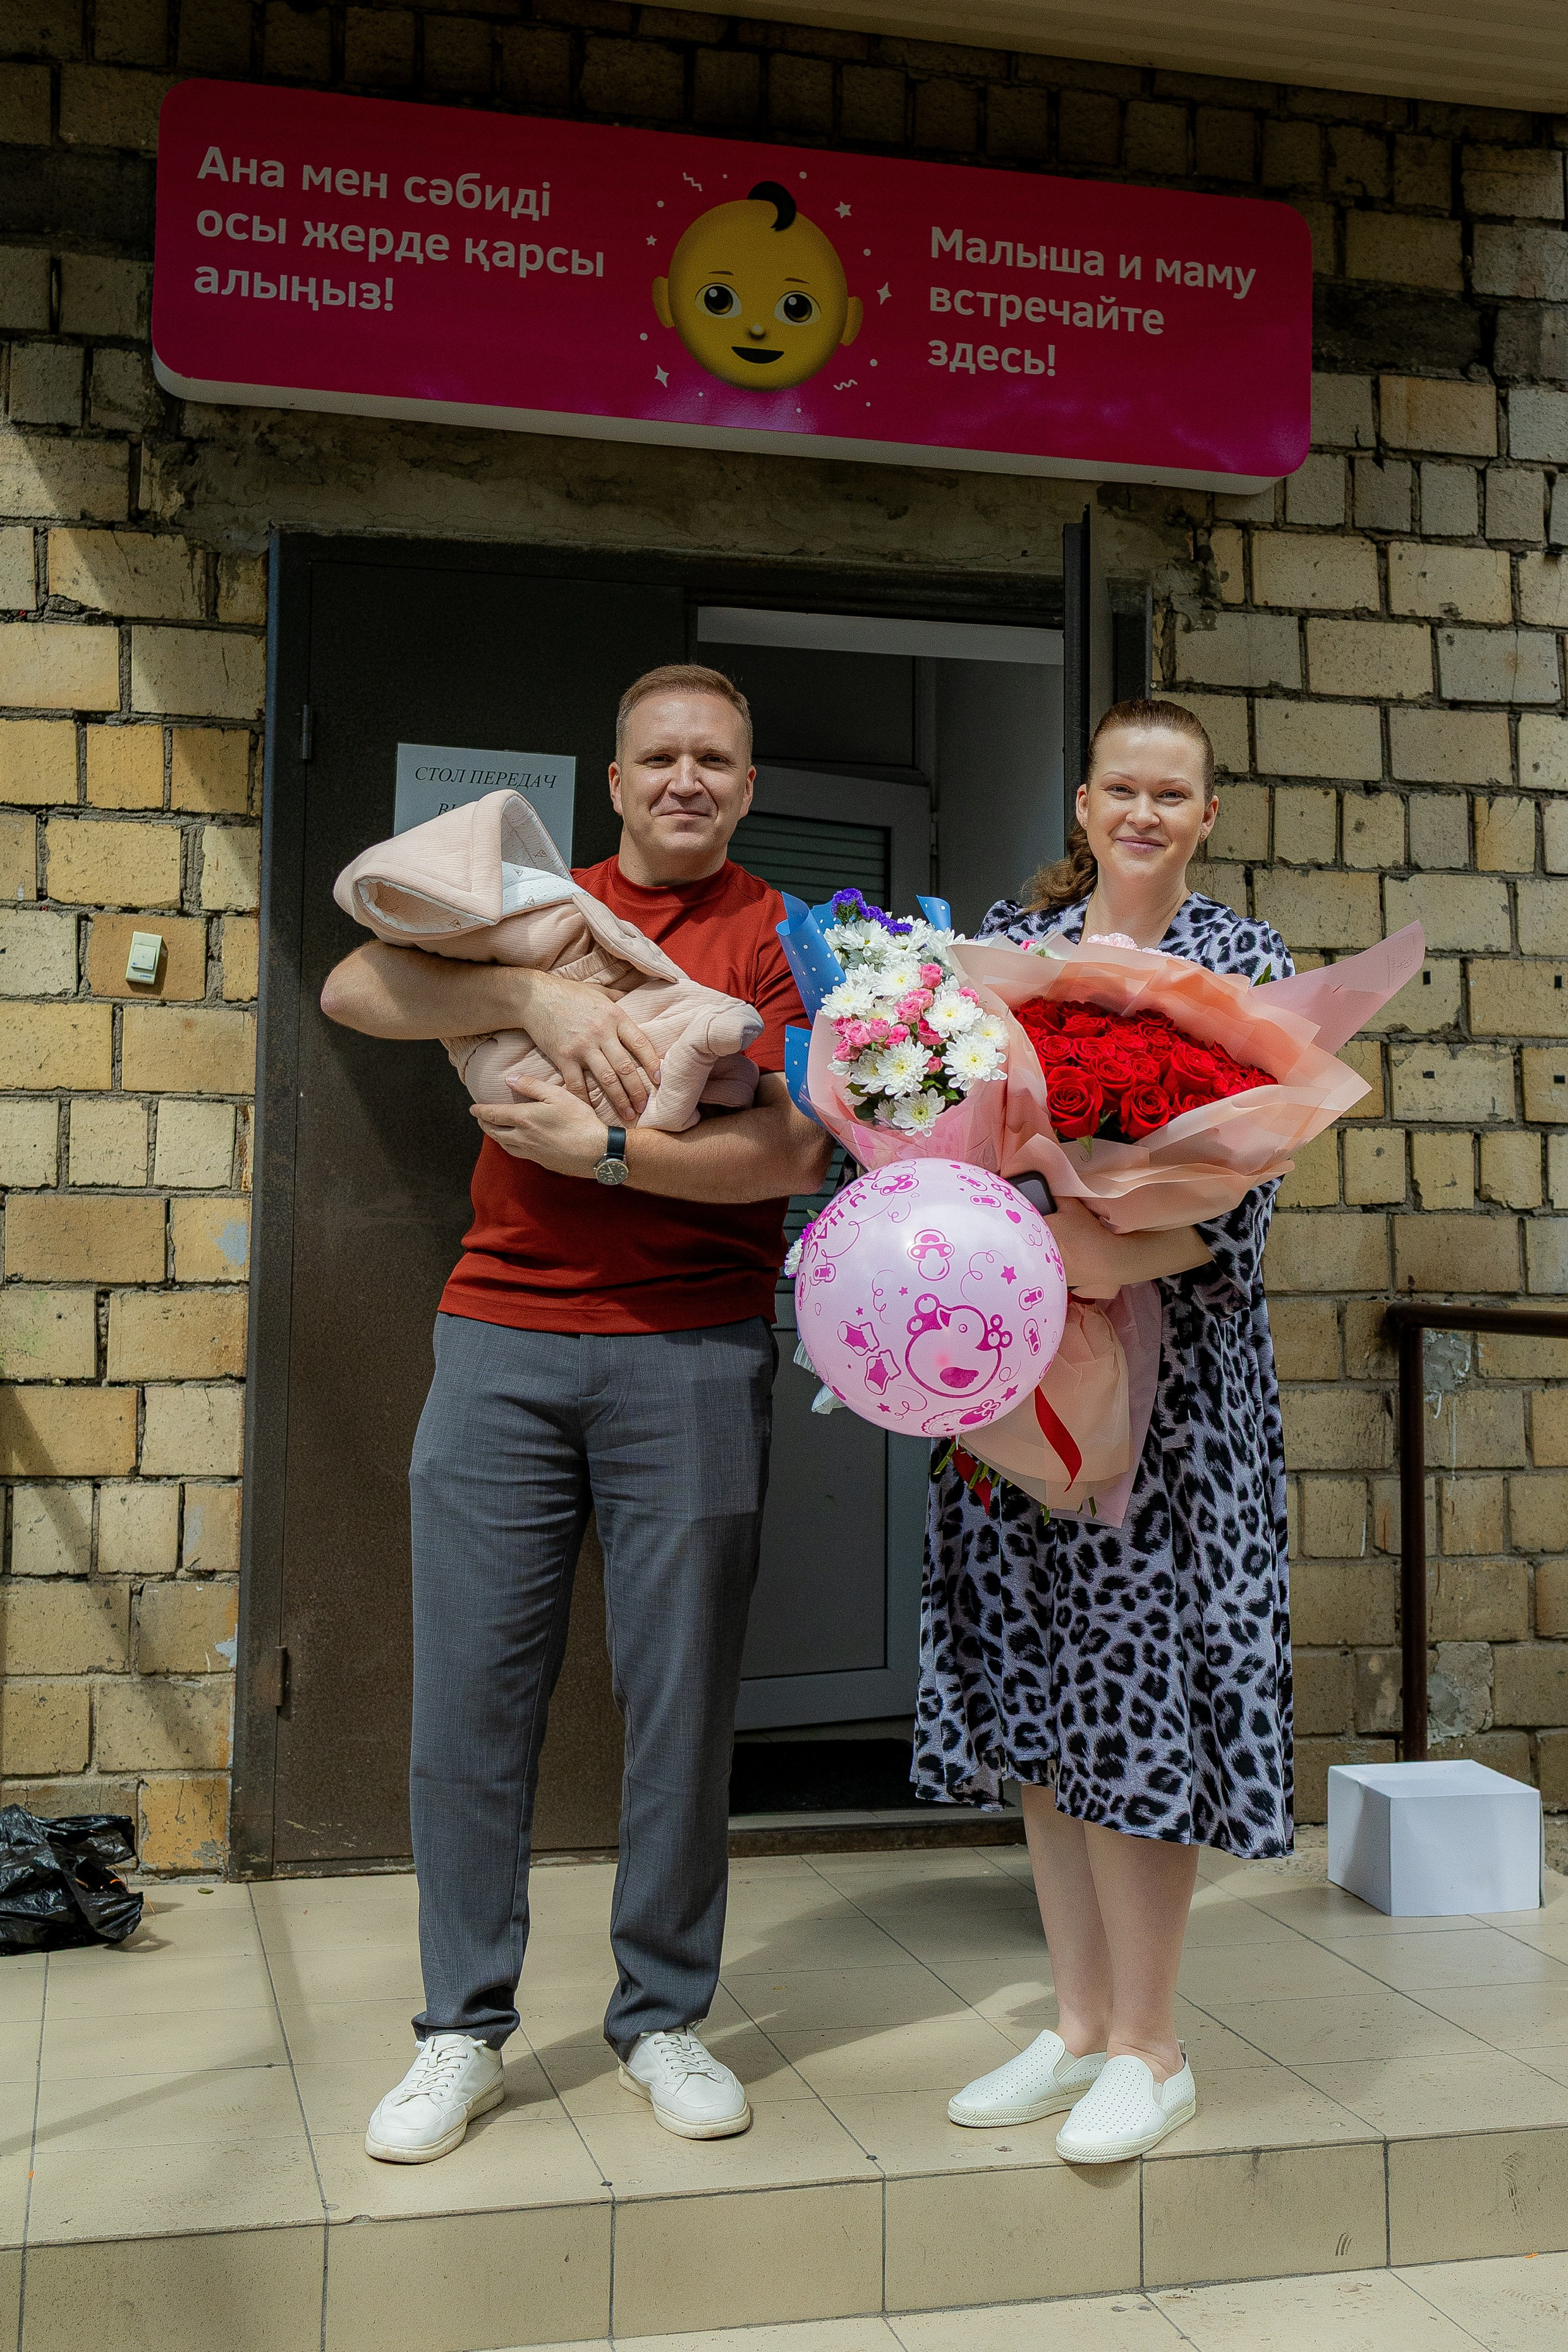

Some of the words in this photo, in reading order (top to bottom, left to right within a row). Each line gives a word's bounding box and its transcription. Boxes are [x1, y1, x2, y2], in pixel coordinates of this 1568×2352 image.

[197, 146, 285, 188] Ана
[302, 164, 388, 199] мен
[404, 172, 551, 221] сәбиді
[196, 209, 287, 244] осы
[301, 219, 450, 263] жерде
[464, 237, 605, 278] қарсы
[930, 226, 1104, 277] Малыша
[1118, 254, 1142, 281] и
[1155, 258, 1257, 300] маму
[194, 265, 394, 311] алыңыз!
[929, 286, 1165, 336] встречайте
[927, 339, 1056, 377] здесь!
[415, 766, 464, 783] СТОЛ
[470, 770, 558, 790] ПЕРЕДАЧ
